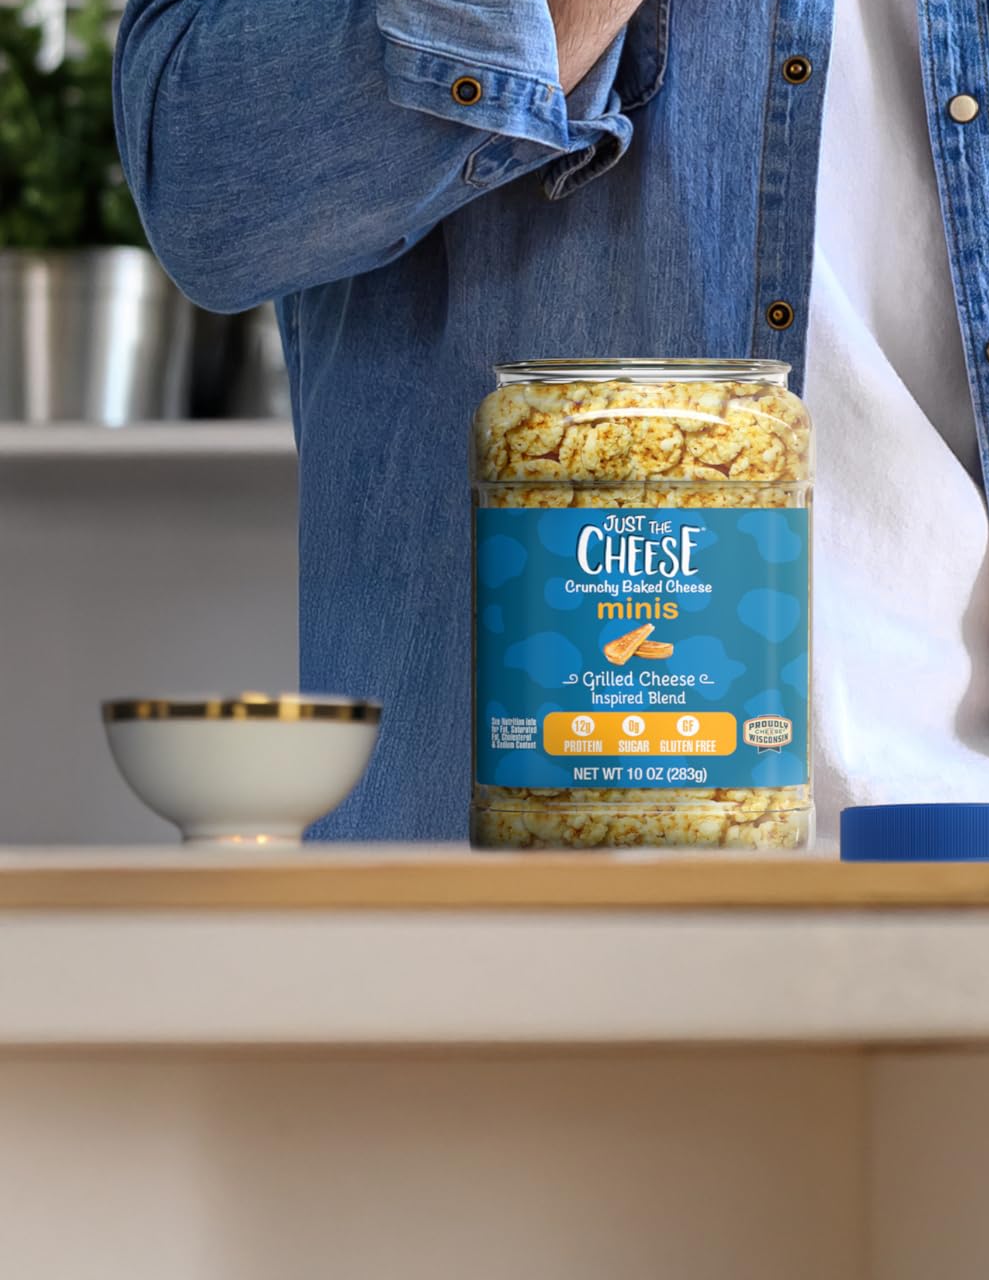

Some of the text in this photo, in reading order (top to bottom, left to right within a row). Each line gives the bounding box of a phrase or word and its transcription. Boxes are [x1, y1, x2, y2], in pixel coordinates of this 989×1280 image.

[603, 515, 672, 535] JUST THE
[576, 524, 701, 578] CHEESE
[564, 579, 713, 596] Crunchy Baked Cheese
[597, 597, 679, 620] minis
[582, 671, 696, 691] Grilled Cheese
[591, 691, 687, 708] Inspired Blend
[574, 719, 591, 733] 12g
[628, 719, 640, 733] 0g
[682, 719, 694, 733] GF
[748, 720, 789, 730] PROUDLY
[563, 740, 603, 753] PROTEIN
[618, 740, 650, 753] SUGAR
[659, 740, 717, 753] GLUTEN FREE
[573, 767, 708, 783] NET WT 10 OZ (283g)
